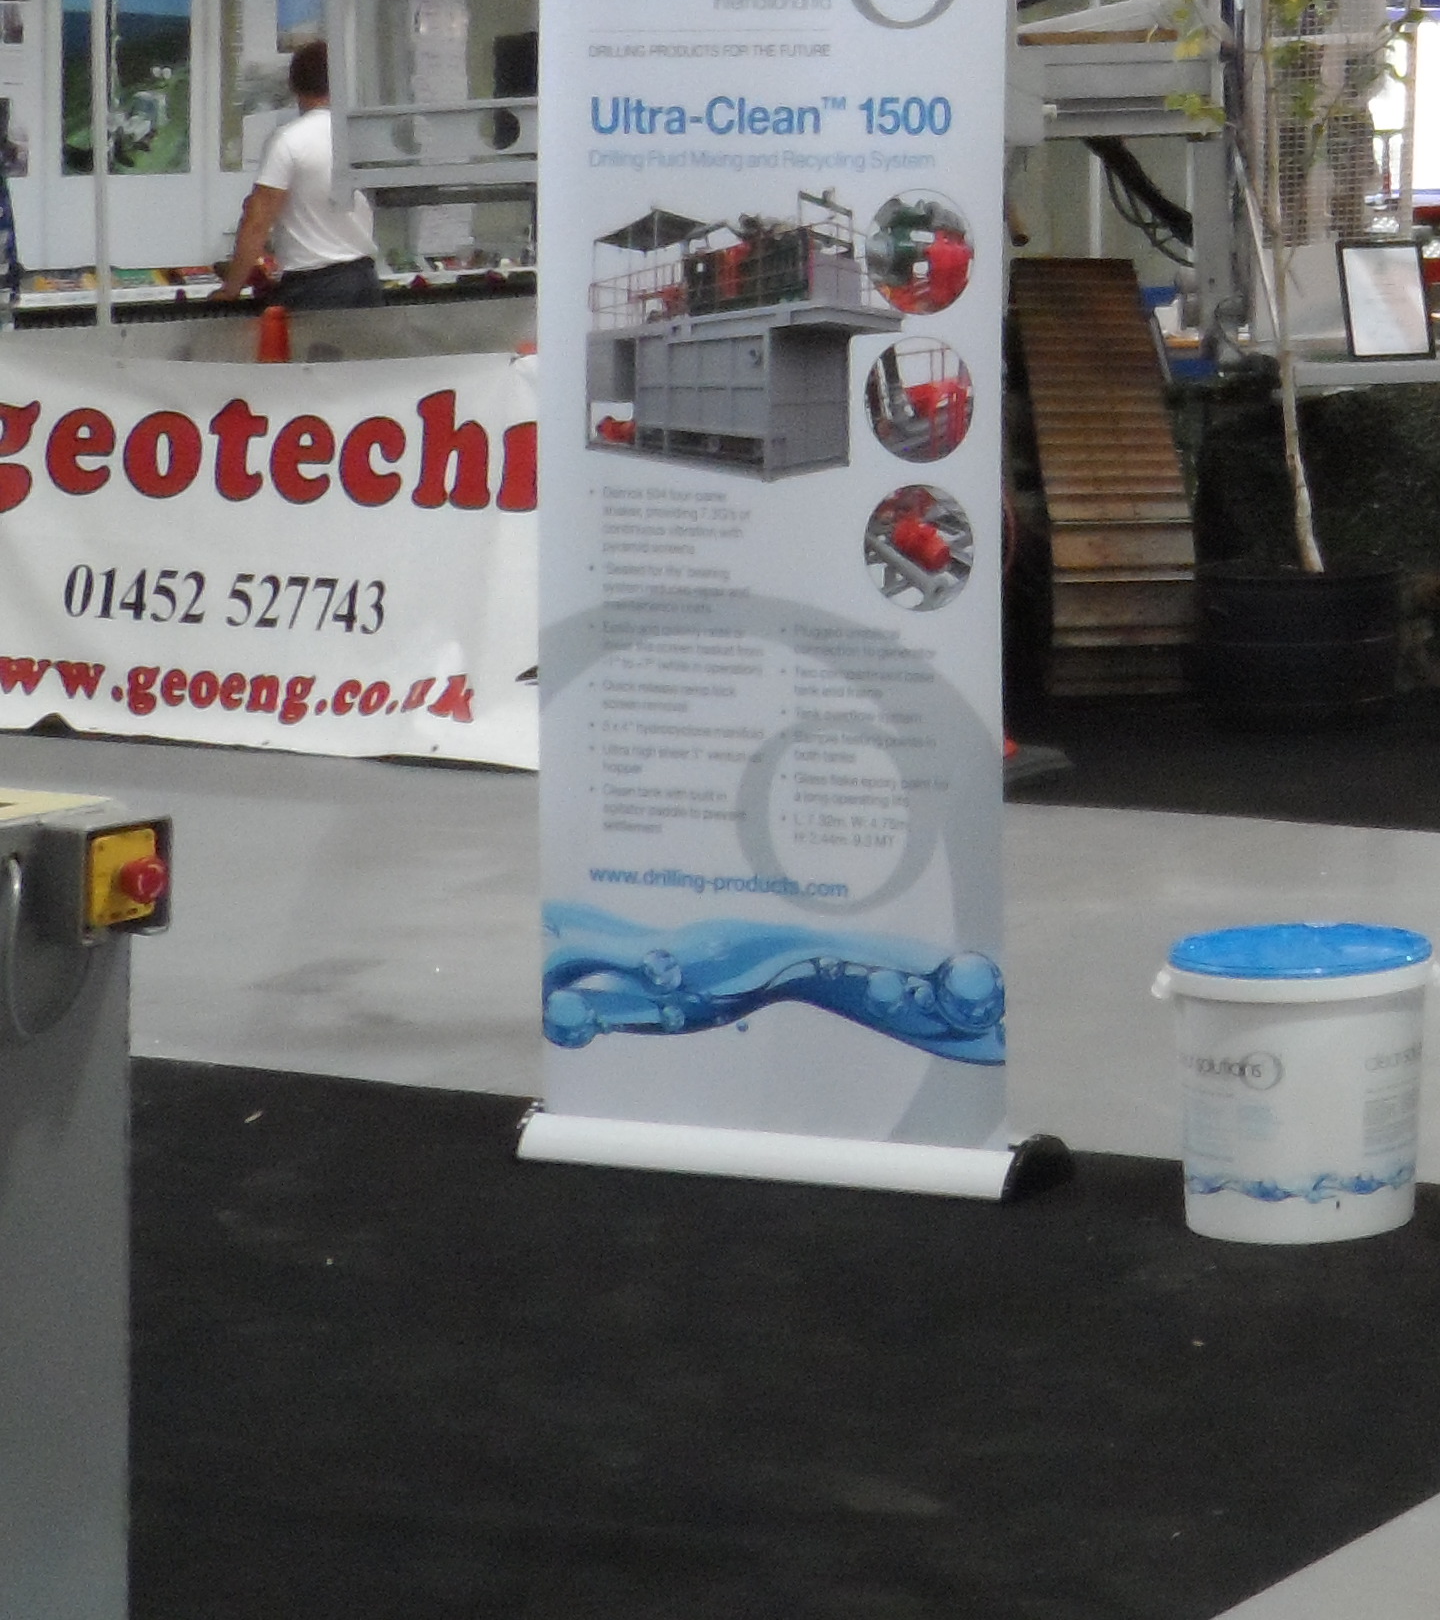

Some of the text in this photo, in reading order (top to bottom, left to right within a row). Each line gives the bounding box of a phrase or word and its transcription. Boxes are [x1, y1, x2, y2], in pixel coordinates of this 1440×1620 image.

[589, 43, 832, 58] DRILLING PRODUCTS FOR THE FUTURE
[858, 96, 952, 136] 1500
[588, 150, 936, 173] Drilling Fluid Mixing and Recycling System
[63, 563, 388, 636] 01452 527743
[589, 867, 849, 898] www.drilling-products.com
